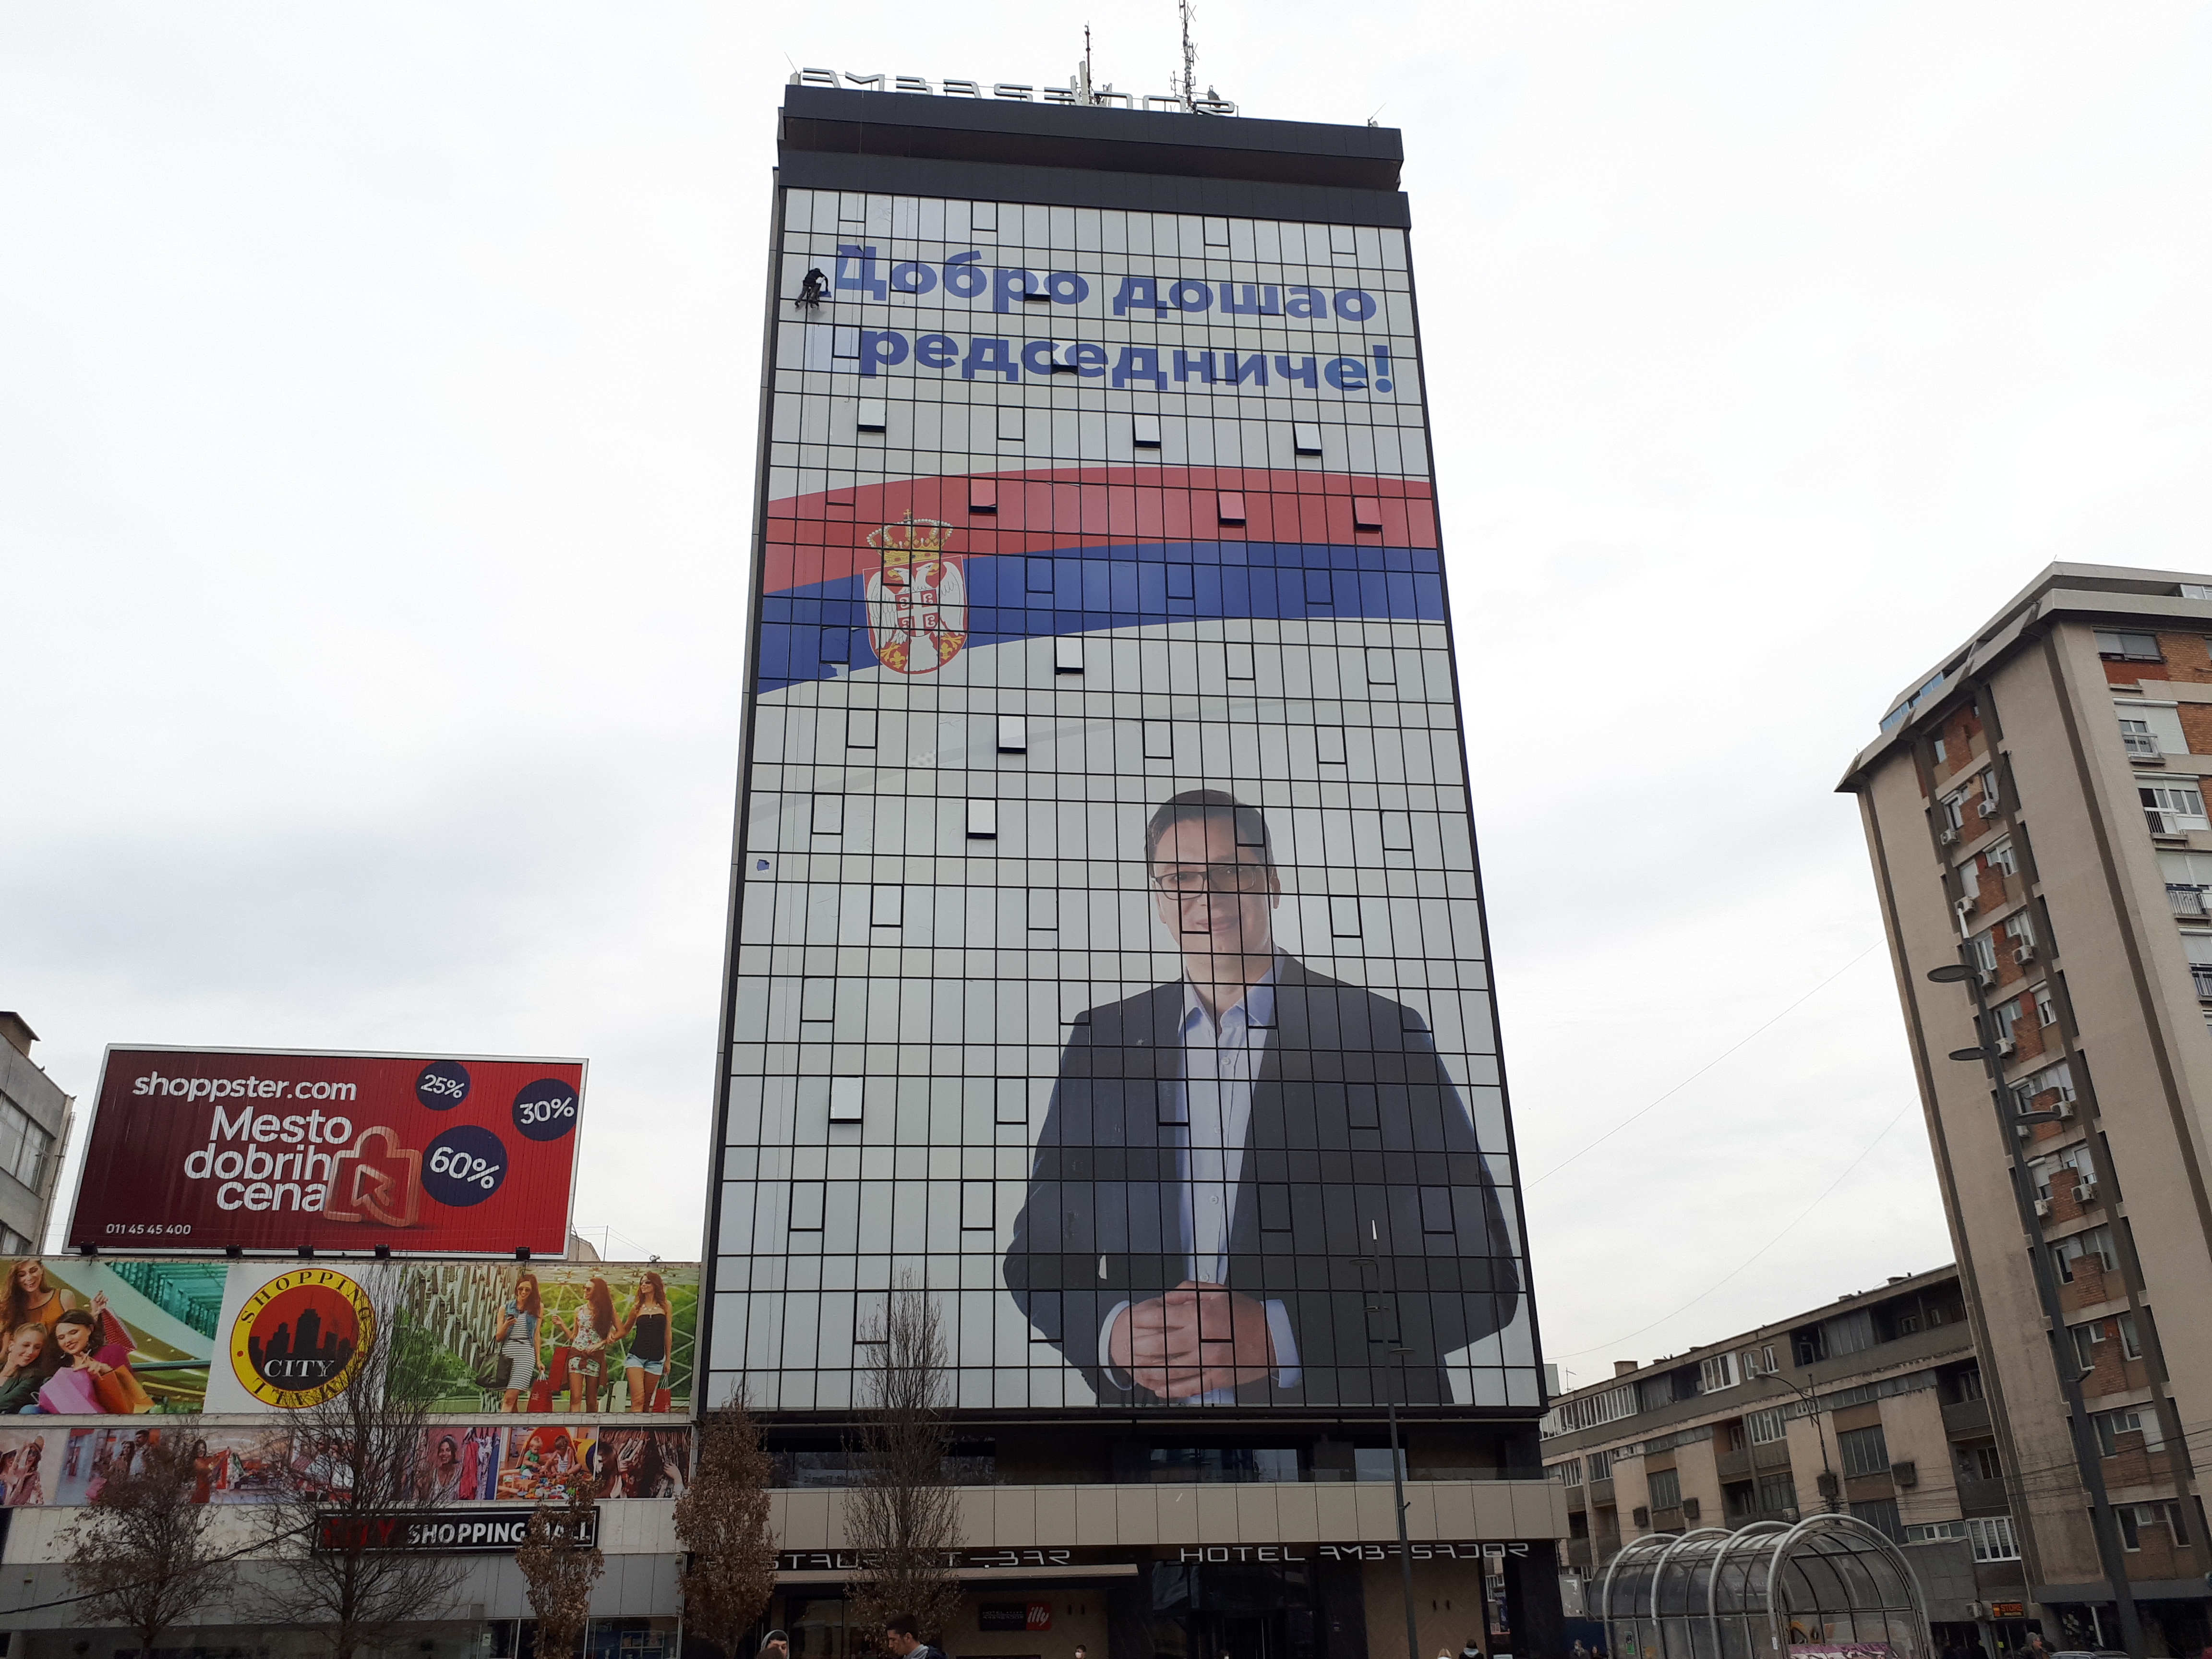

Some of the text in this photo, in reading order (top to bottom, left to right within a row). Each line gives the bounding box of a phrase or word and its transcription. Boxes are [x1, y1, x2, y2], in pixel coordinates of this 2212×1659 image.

[836, 244, 1377, 322] Добро дошао
[132, 1070, 357, 1102] shoppster.com
[421, 1074, 465, 1098] 25%
[209, 1105, 353, 1145] Mesto
[519, 1096, 575, 1124] 30%
[184, 1141, 333, 1181] dobrih
[430, 1146, 500, 1189] 60%
[216, 1178, 325, 1213] cena
[106, 1224, 191, 1235] 011 45 45 400
[240, 1271, 369, 1324] SHOPPING
[264, 1358, 335, 1378] CITY
[407, 1522, 526, 1544] SHOPPING
[1180, 1546, 1306, 1563] HOTEL
[1027, 1606, 1050, 1626] illy
